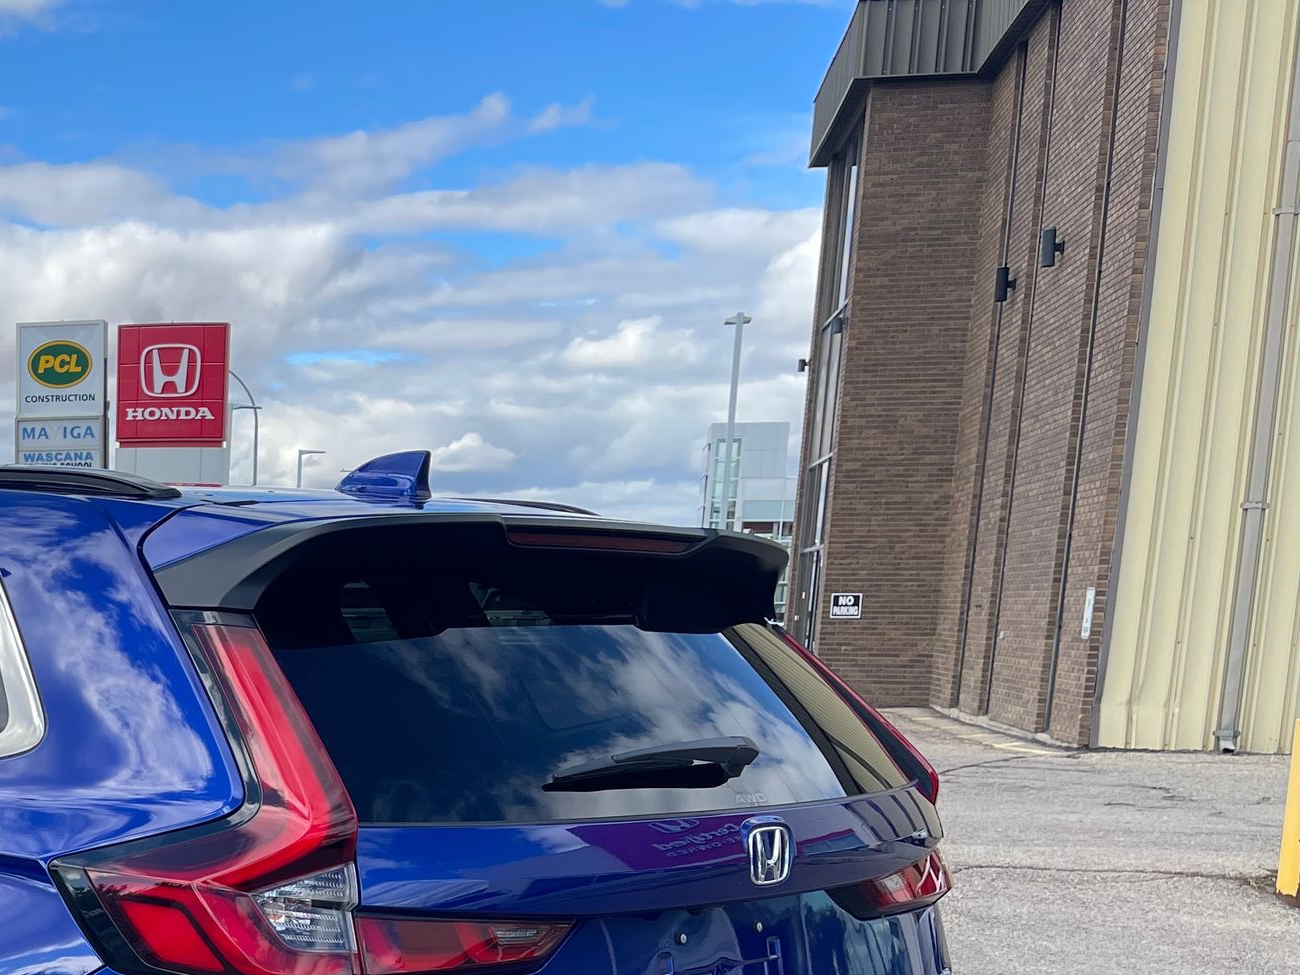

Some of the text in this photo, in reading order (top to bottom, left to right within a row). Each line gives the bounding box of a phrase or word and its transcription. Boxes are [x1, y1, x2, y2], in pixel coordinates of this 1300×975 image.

[38, 353, 82, 373] PCL
[24, 394, 96, 403] CONSTRUCTION
[125, 406, 216, 421] HONDA
[23, 451, 94, 463] WASCANA
[838, 596, 855, 605] NO
[833, 606, 858, 615] PARKING
[735, 792, 767, 805] AWD
